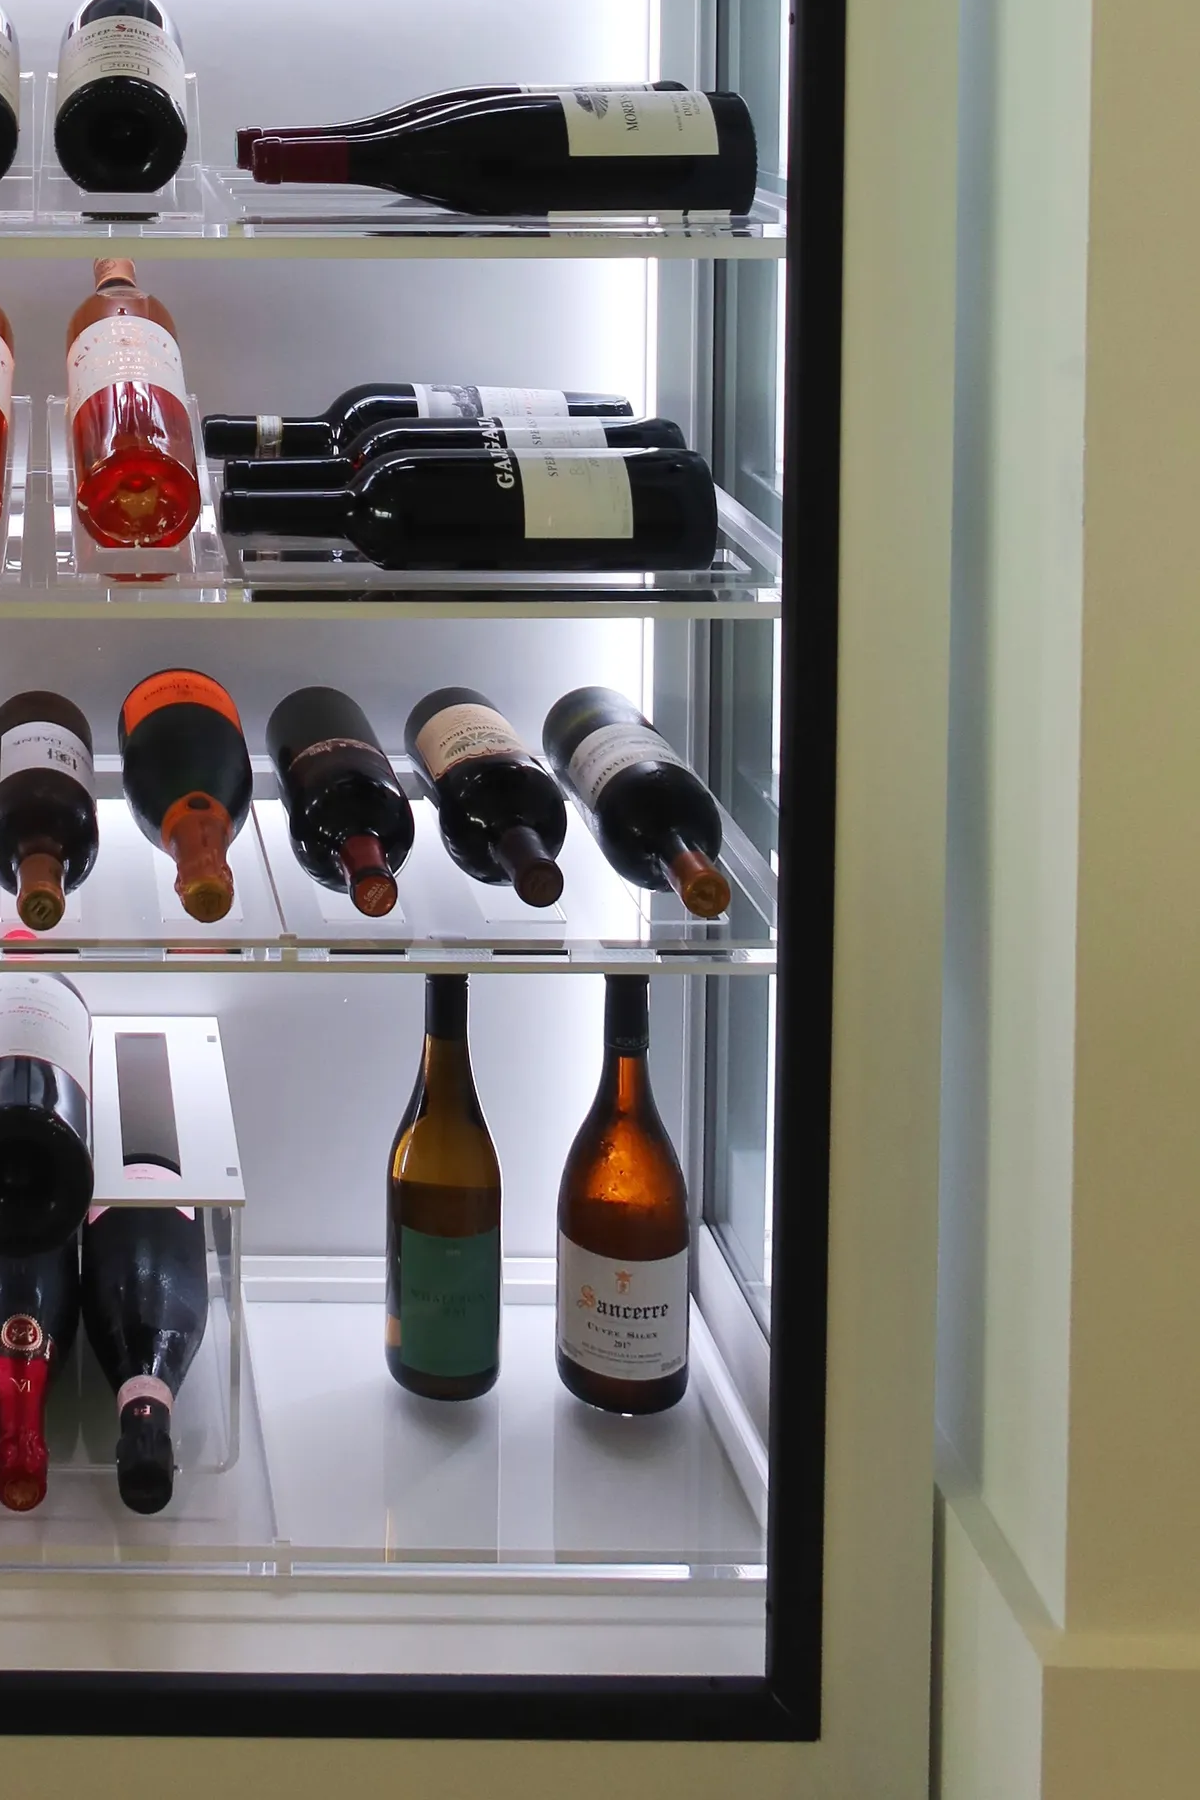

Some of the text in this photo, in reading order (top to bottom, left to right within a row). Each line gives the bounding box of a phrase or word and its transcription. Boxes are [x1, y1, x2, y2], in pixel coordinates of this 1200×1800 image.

[439, 730, 464, 749] Rock
[576, 1284, 670, 1321] Sancerre
[614, 1339, 631, 1350] 2017
